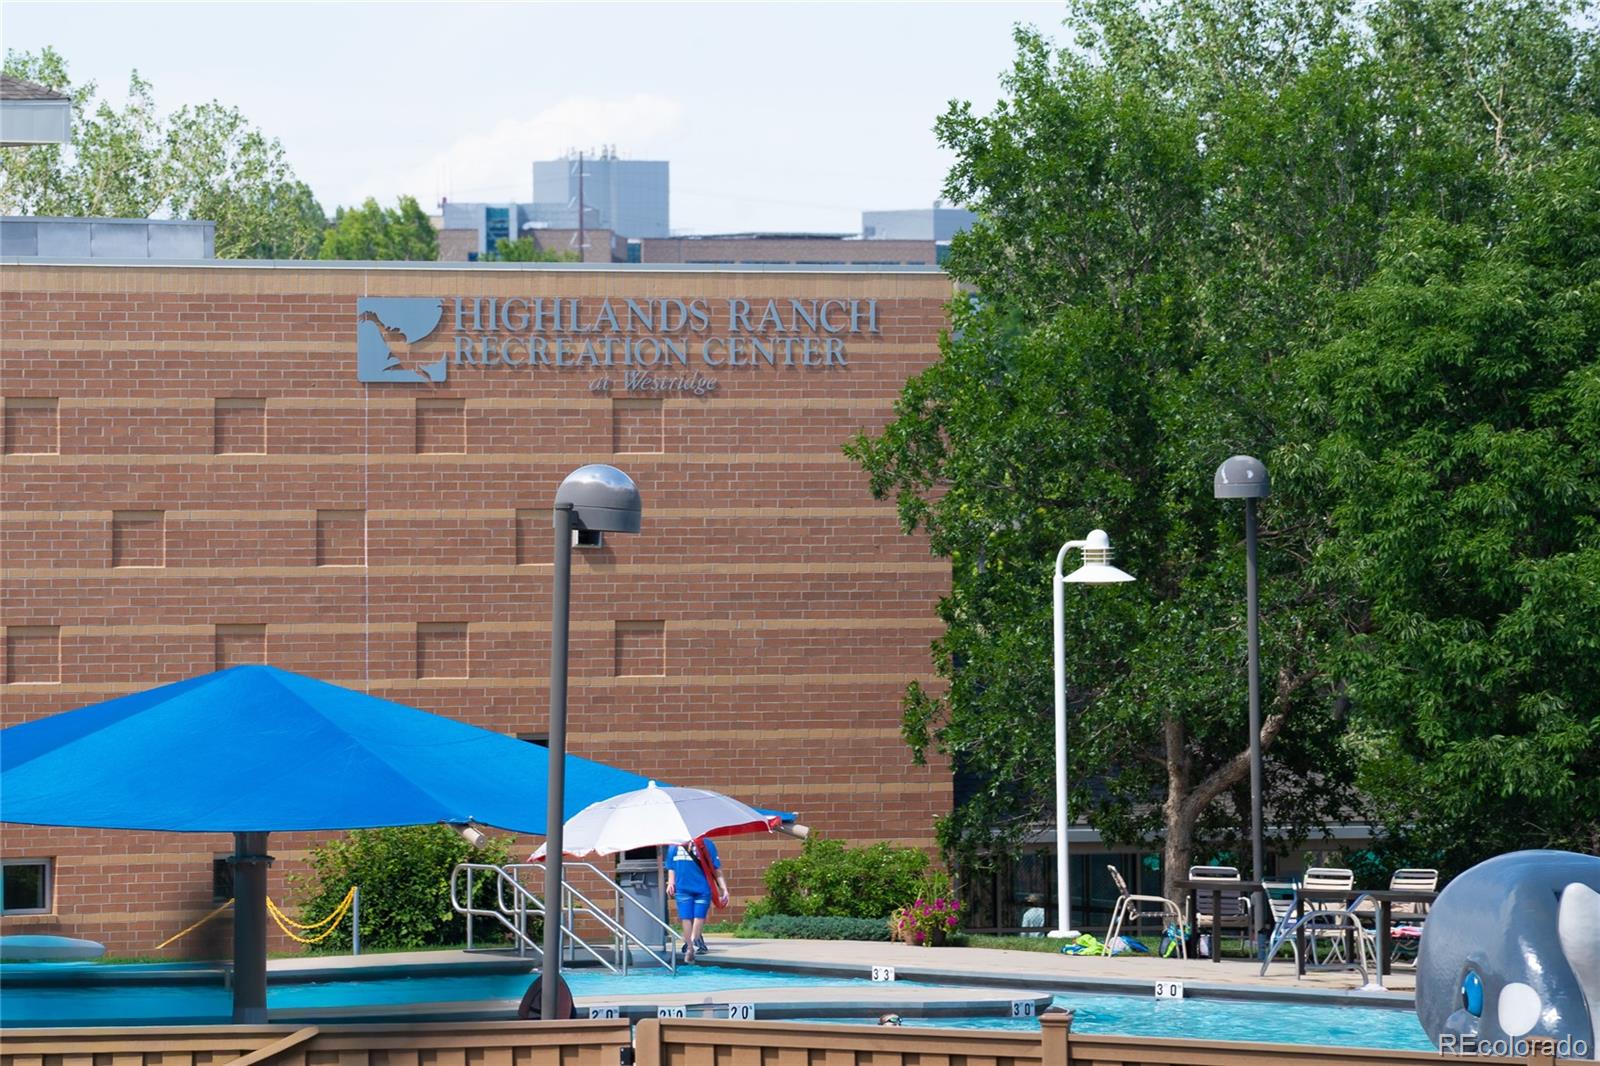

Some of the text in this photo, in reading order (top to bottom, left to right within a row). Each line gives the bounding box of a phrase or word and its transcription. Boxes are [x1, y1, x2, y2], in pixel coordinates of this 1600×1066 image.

[453, 296, 881, 333] HIGHLANDS RANCH
[453, 335, 849, 367] RECREATION CENTER
[588, 368, 718, 395] at Westridge
